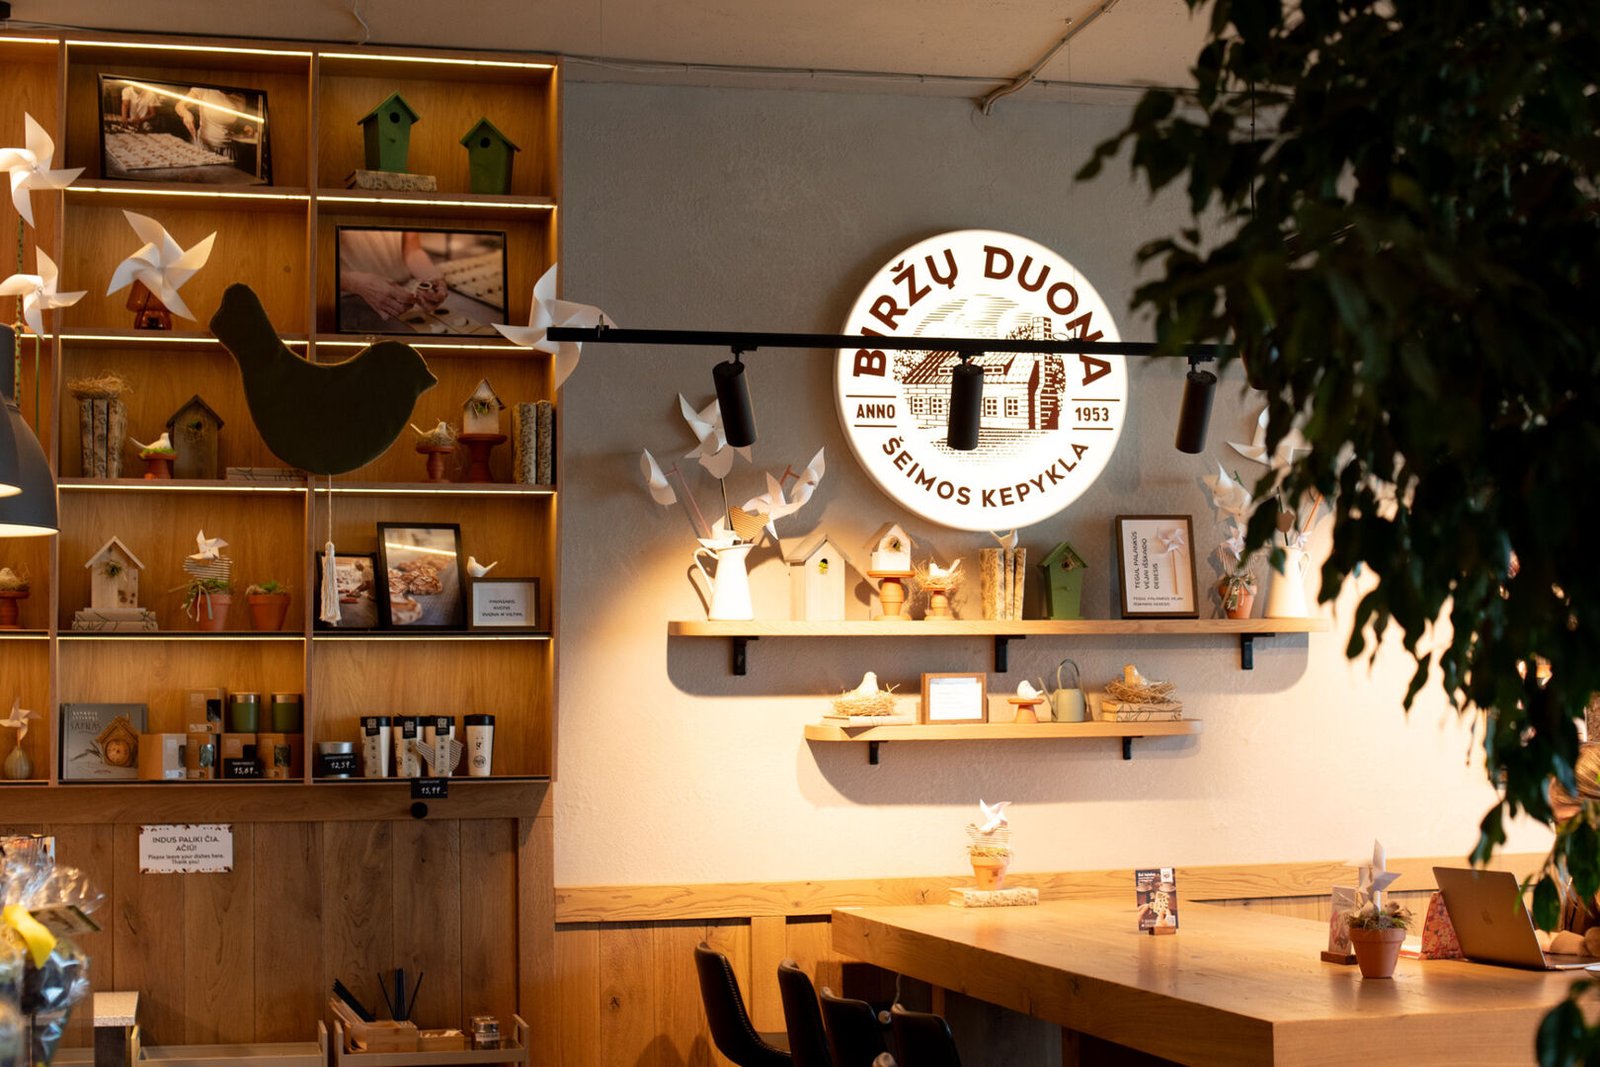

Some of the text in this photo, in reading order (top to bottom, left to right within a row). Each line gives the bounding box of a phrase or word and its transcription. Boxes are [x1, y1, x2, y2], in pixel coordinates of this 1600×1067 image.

[983, 245, 1112, 387] DUONA
[856, 403, 896, 419] ANNO
[1075, 406, 1109, 422] 1953
[882, 436, 1089, 508] ŠEIMOS KEPYKLA
[152, 836, 177, 844] INDUS
[178, 835, 204, 843] PALIKI
